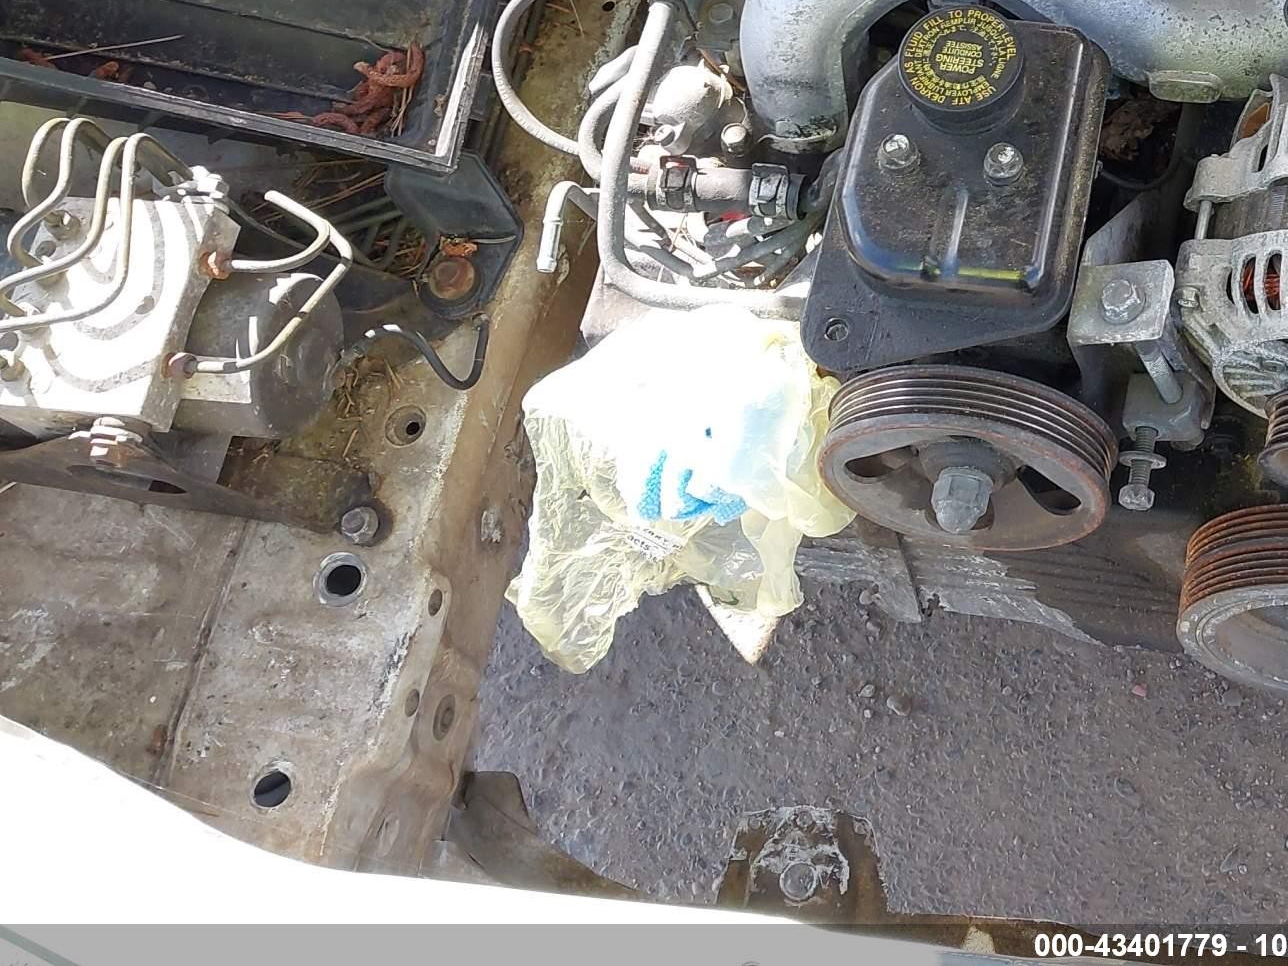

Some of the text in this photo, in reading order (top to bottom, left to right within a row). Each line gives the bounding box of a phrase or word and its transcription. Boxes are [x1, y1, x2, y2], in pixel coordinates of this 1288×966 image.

[947, 9, 963, 19] TO
[967, 9, 1005, 32] PROPER
[923, 16, 944, 31] FILL
[904, 31, 923, 58] FLUID
[941, 46, 983, 58] CONDUITE
[1001, 32, 1017, 61] LEVEL
[904, 61, 915, 73] AS
[935, 53, 985, 68] STEERING
[940, 62, 976, 74] POWER
[910, 77, 946, 104] DEXRON
[945, 81, 990, 97] EMPLOYER
[976, 85, 997, 101] USE
[952, 95, 972, 106] ATF
